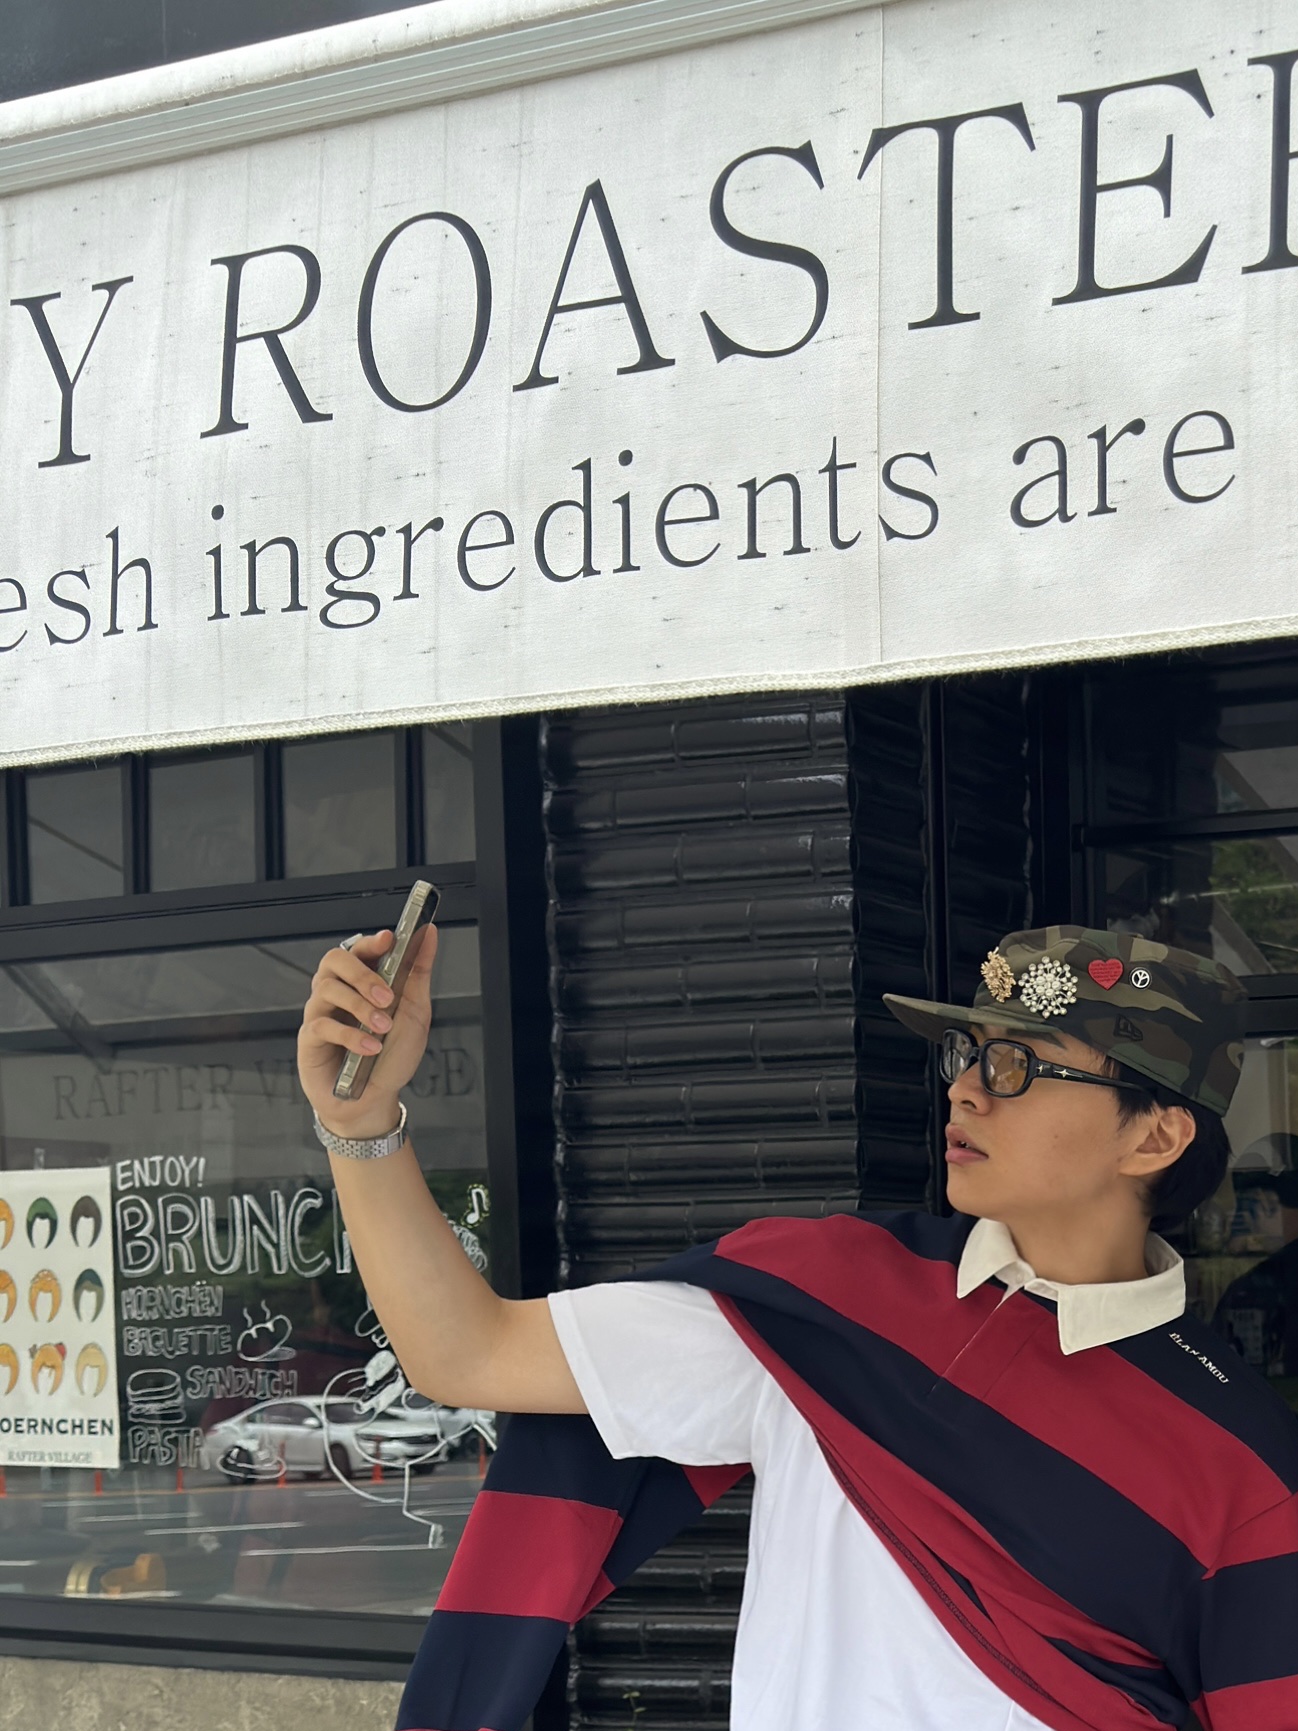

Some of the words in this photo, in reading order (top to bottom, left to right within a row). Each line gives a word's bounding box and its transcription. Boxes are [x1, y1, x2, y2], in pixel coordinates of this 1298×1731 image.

[11, 275, 134, 469] Y
[206, 435, 941, 628] ingredients
[1010, 409, 1236, 529] are
[53, 1062, 237, 1121] RAFTER
[255, 1046, 478, 1108] VIGE
[116, 1156, 206, 1191] ENJOY!
[122, 1324, 233, 1360] BAGUETTE
[186, 1366, 298, 1400] SANDWICH
[0, 1418, 114, 1435] OERNCHEN
[128, 1426, 210, 1470] PASTA
